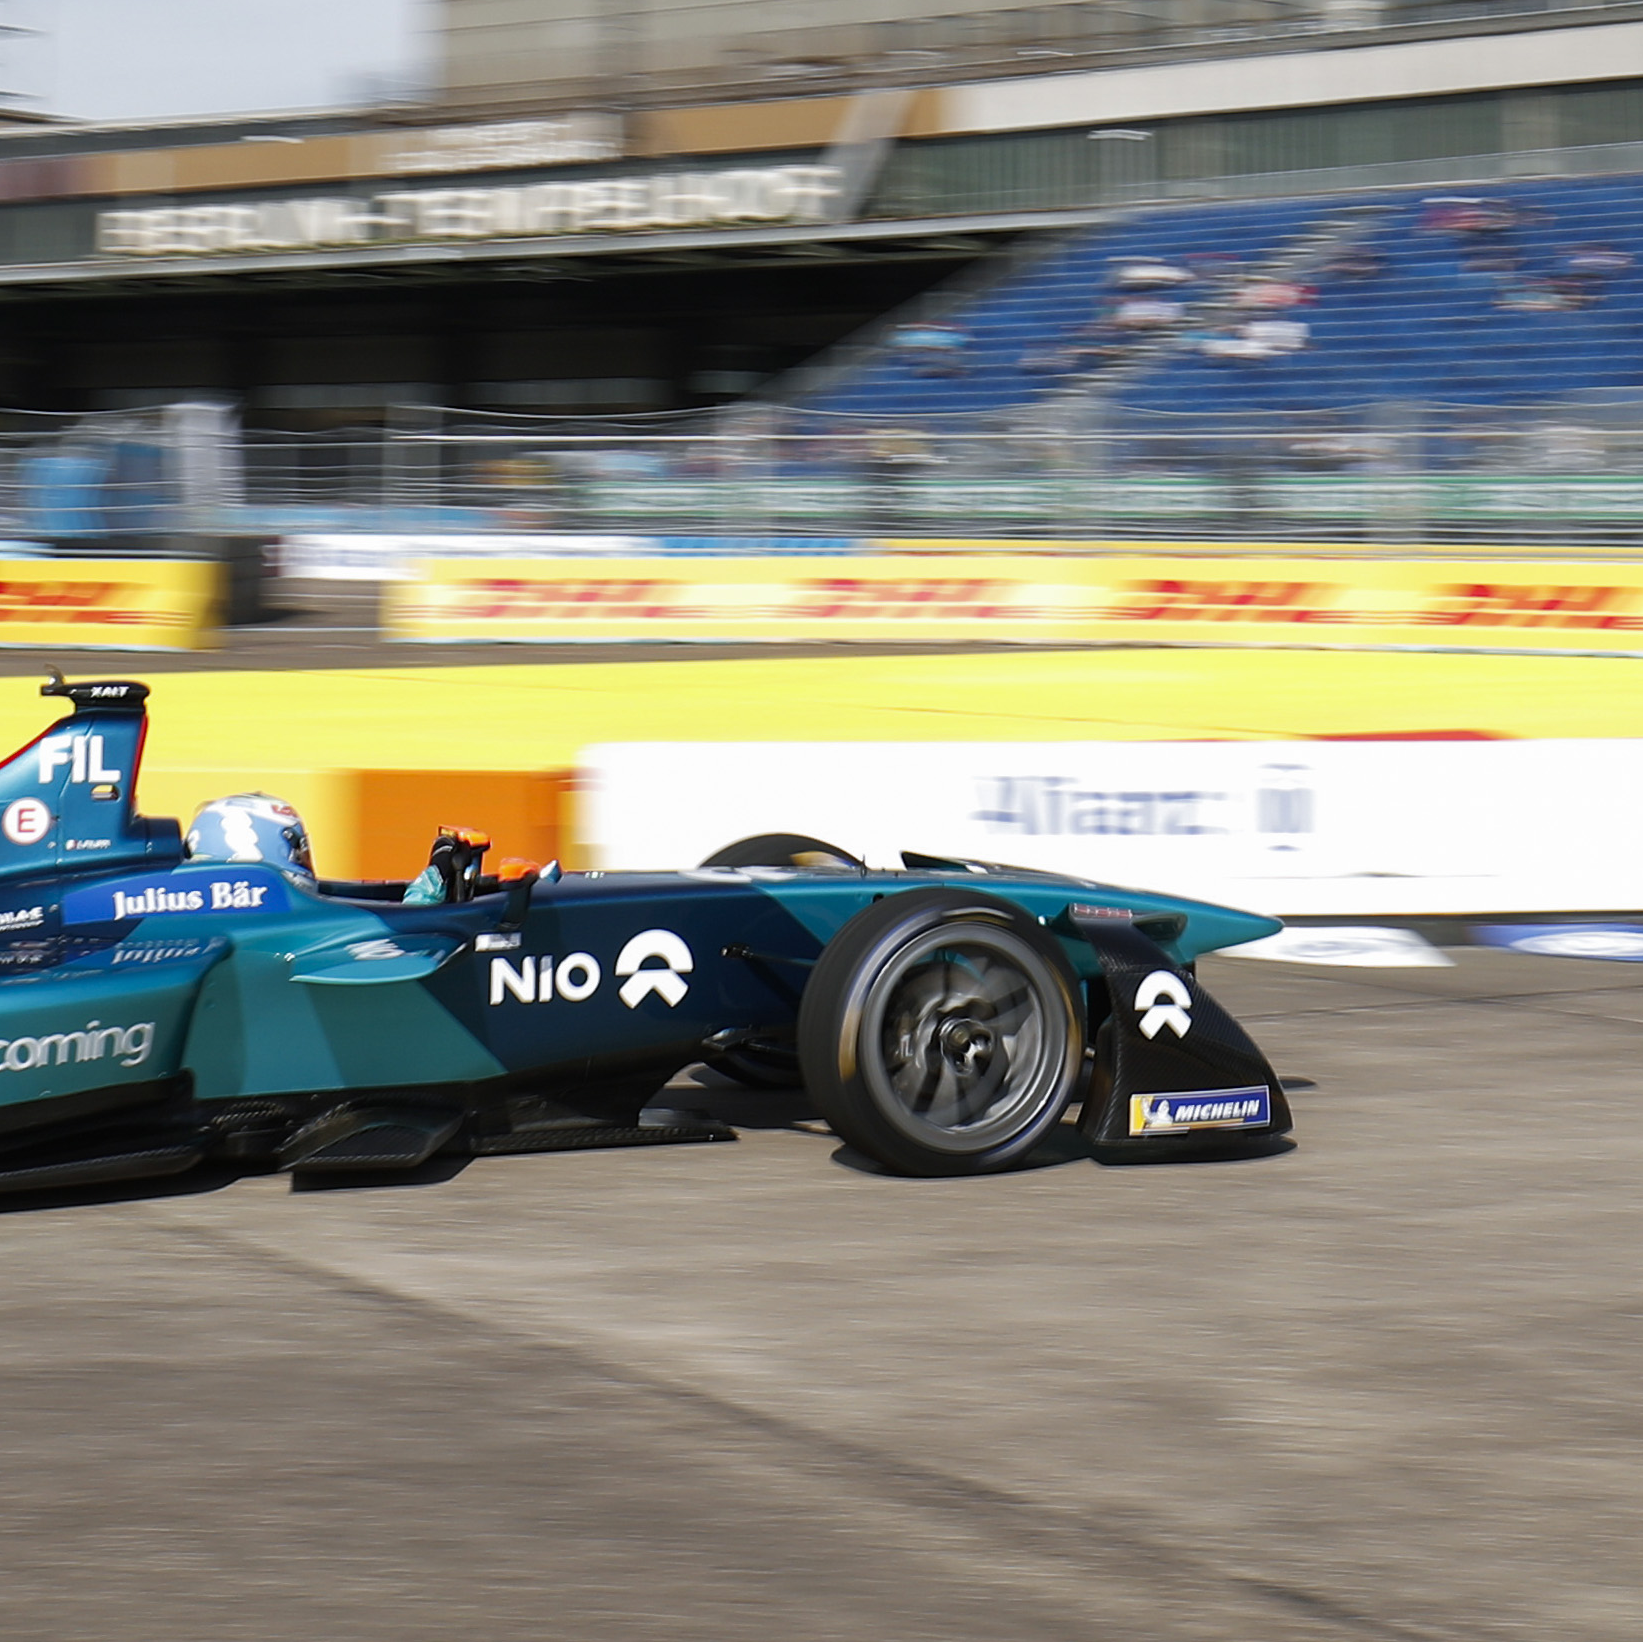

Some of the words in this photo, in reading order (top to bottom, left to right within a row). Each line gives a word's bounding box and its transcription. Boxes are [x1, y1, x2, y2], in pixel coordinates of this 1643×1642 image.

[39, 735, 121, 783] FIL
[112, 887, 204, 920] Julius
[210, 880, 268, 909] Bär
[490, 951, 601, 1005] NIO
[1174, 1099, 1260, 1122] MICHELIN
